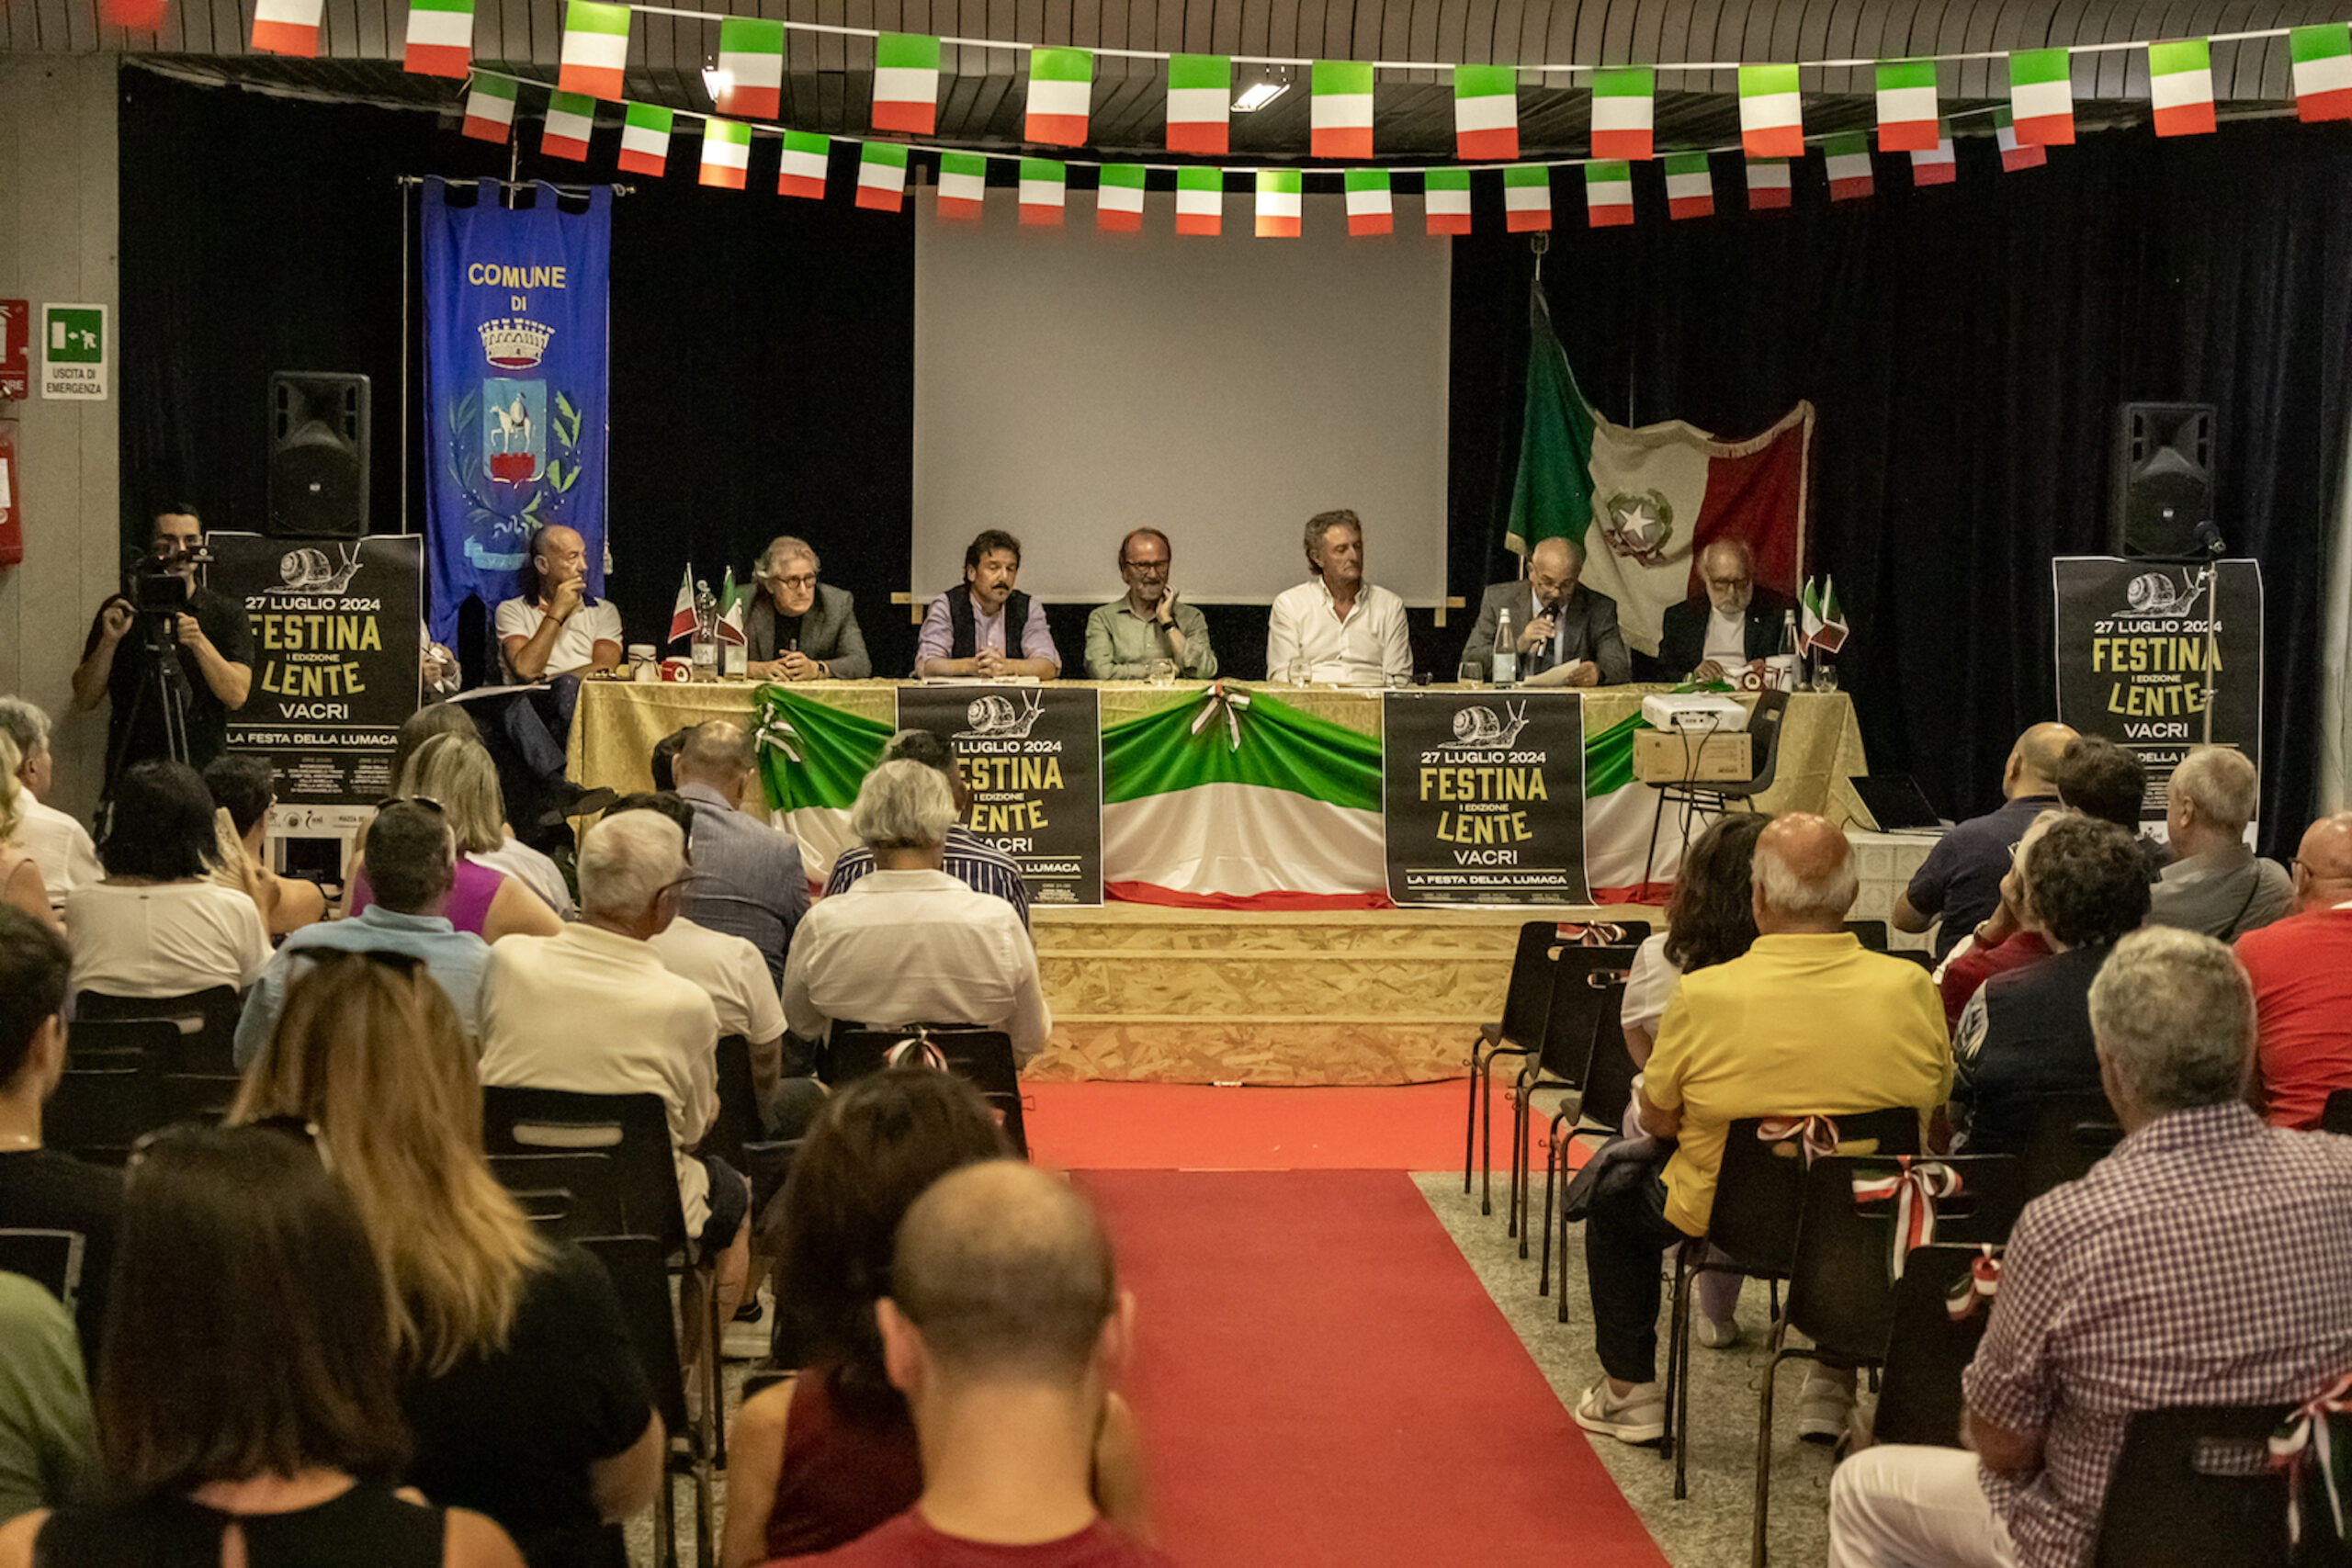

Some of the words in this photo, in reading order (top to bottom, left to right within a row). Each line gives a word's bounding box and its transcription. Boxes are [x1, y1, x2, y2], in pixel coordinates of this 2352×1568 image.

[469, 263, 566, 288] COMUNE
[511, 296, 526, 311] DI
[52, 368, 85, 379] USCITA
[87, 368, 96, 379] DI
[46, 382, 101, 394] EMERGENZA
[245, 596, 266, 610] 27
[271, 597, 336, 611] LUGLIO
[340, 598, 380, 611] 2024
[2095, 621, 2114, 634] 27
[2118, 621, 2179, 634] LUGLIO
[2182, 620, 2222, 633] 2024
[291, 653, 340, 662] EDIZIONE
[2093, 637, 2223, 672] FESTINA
[261, 660, 366, 697] LENTE
[2137, 674, 2181, 683] EDIZIONE
[2108, 682, 2206, 716] LENTE
[279, 703, 349, 719] VACRI
[2124, 723, 2188, 738] VACRI
[227, 733, 244, 743] LA
[248, 733, 291, 744] FESTA
[294, 734, 338, 744] DELLA
[342, 734, 399, 745] LUMACA
[958, 740, 1021, 753] LUGLIO
[1023, 740, 1062, 753] 2024
[1421, 751, 1441, 763] 27
[1444, 751, 1505, 764] LUGLIO
[1509, 751, 1546, 764] 2024
[956, 757, 1065, 790] STINA
[1419, 767, 1548, 802] FESTINA
[978, 793, 1024, 802] EDIZIONE
[969, 799, 1048, 832] ENTE
[1464, 804, 1510, 812] EDIZIONE
[1436, 810, 1532, 845] LENTE
[1453, 850, 1518, 865] VACRI
[1026, 863, 1080, 873] LUMACA
[1407, 875, 1424, 884] LA
[1427, 875, 1464, 885] FESTA
[1469, 875, 1511, 885] DELLA
[1513, 875, 1567, 885] LUMACA
